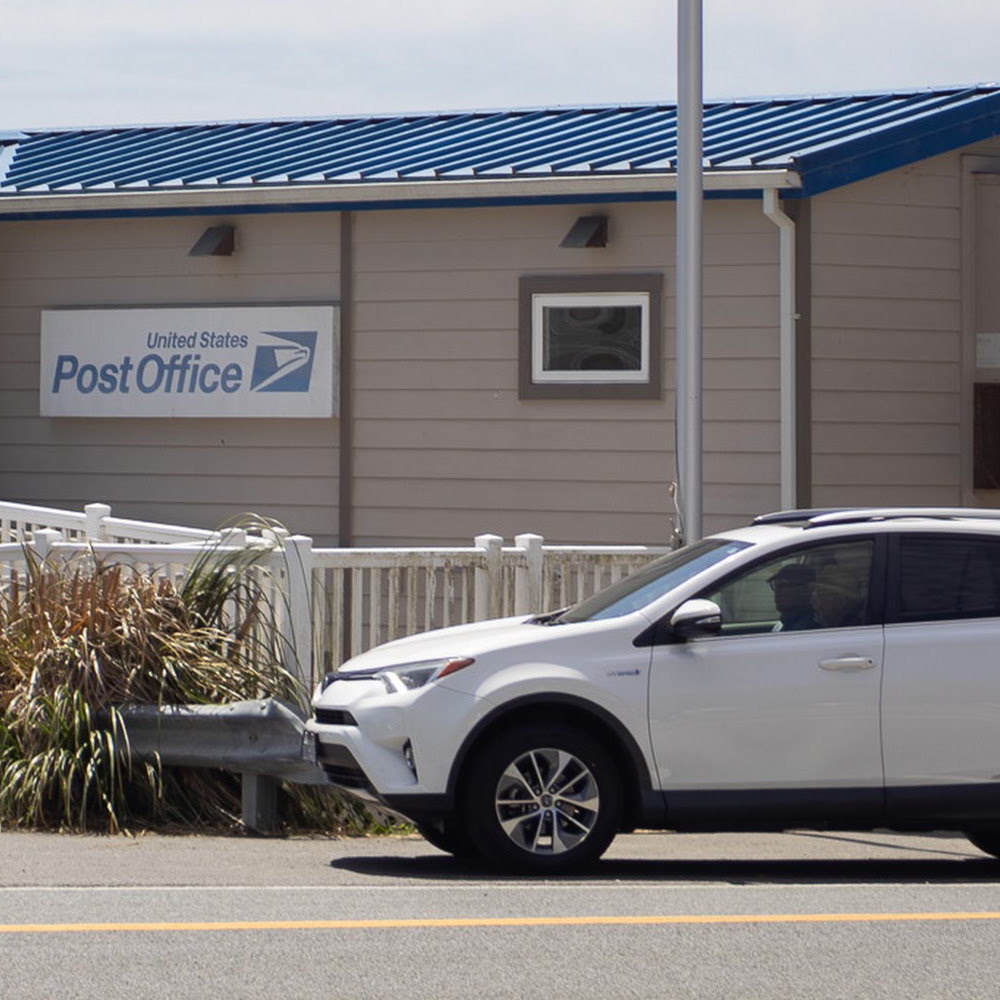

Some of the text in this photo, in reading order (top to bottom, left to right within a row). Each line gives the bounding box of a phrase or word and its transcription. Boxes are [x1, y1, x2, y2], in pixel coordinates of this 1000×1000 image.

[147, 331, 249, 348] United States
[52, 354, 243, 394] Post Office
